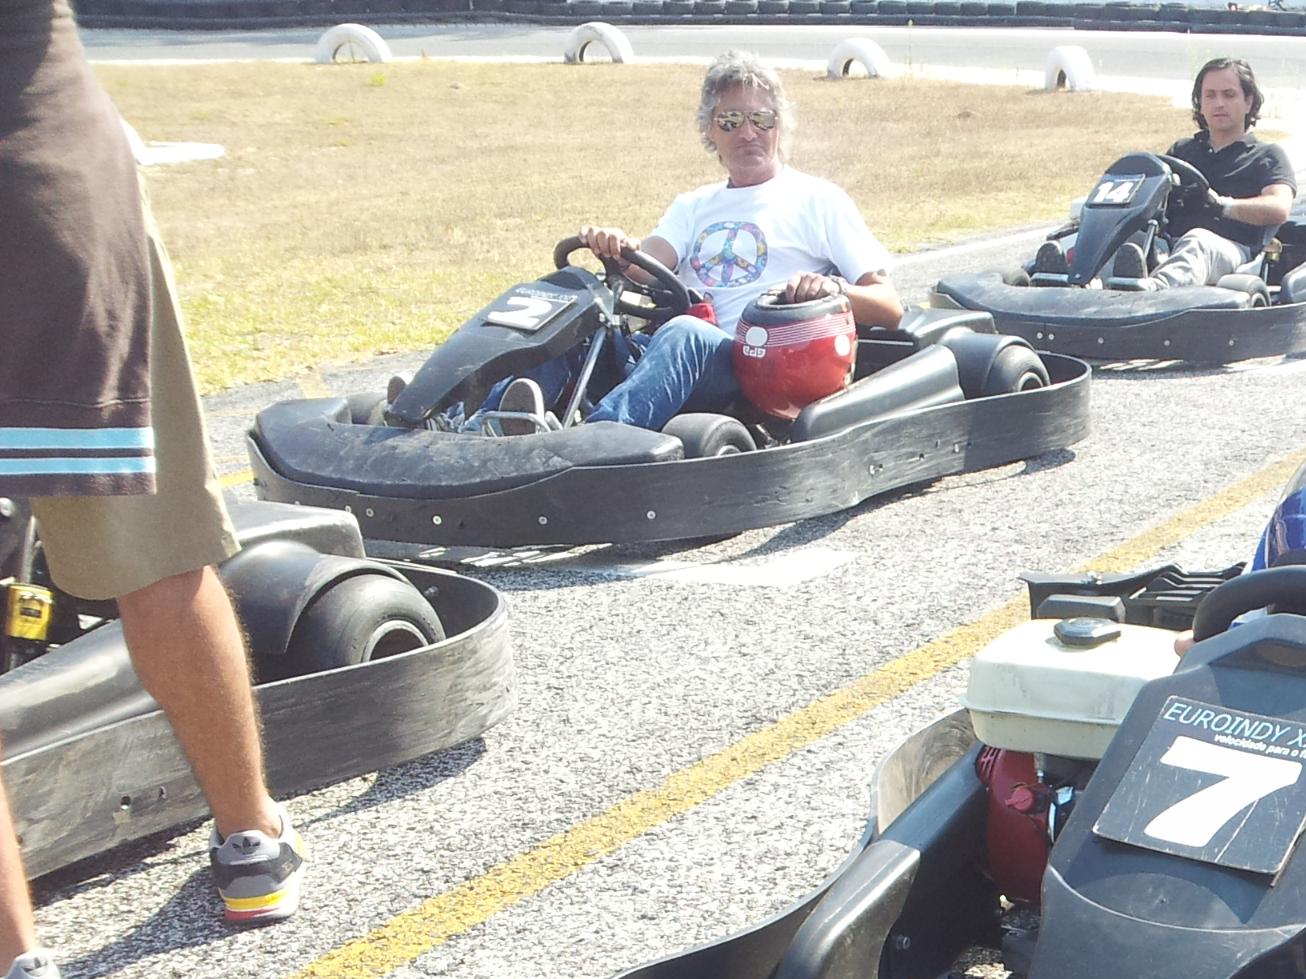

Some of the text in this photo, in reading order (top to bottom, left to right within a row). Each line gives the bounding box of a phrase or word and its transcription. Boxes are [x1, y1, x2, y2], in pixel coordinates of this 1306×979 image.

[1093, 181, 1134, 203] 14
[487, 296, 553, 328] 2
[1163, 702, 1291, 742] EUROINDY
[1214, 734, 1267, 751] velocidade
[1266, 744, 1290, 756] para
[1291, 749, 1299, 757] o
[1144, 735, 1303, 847] 7
